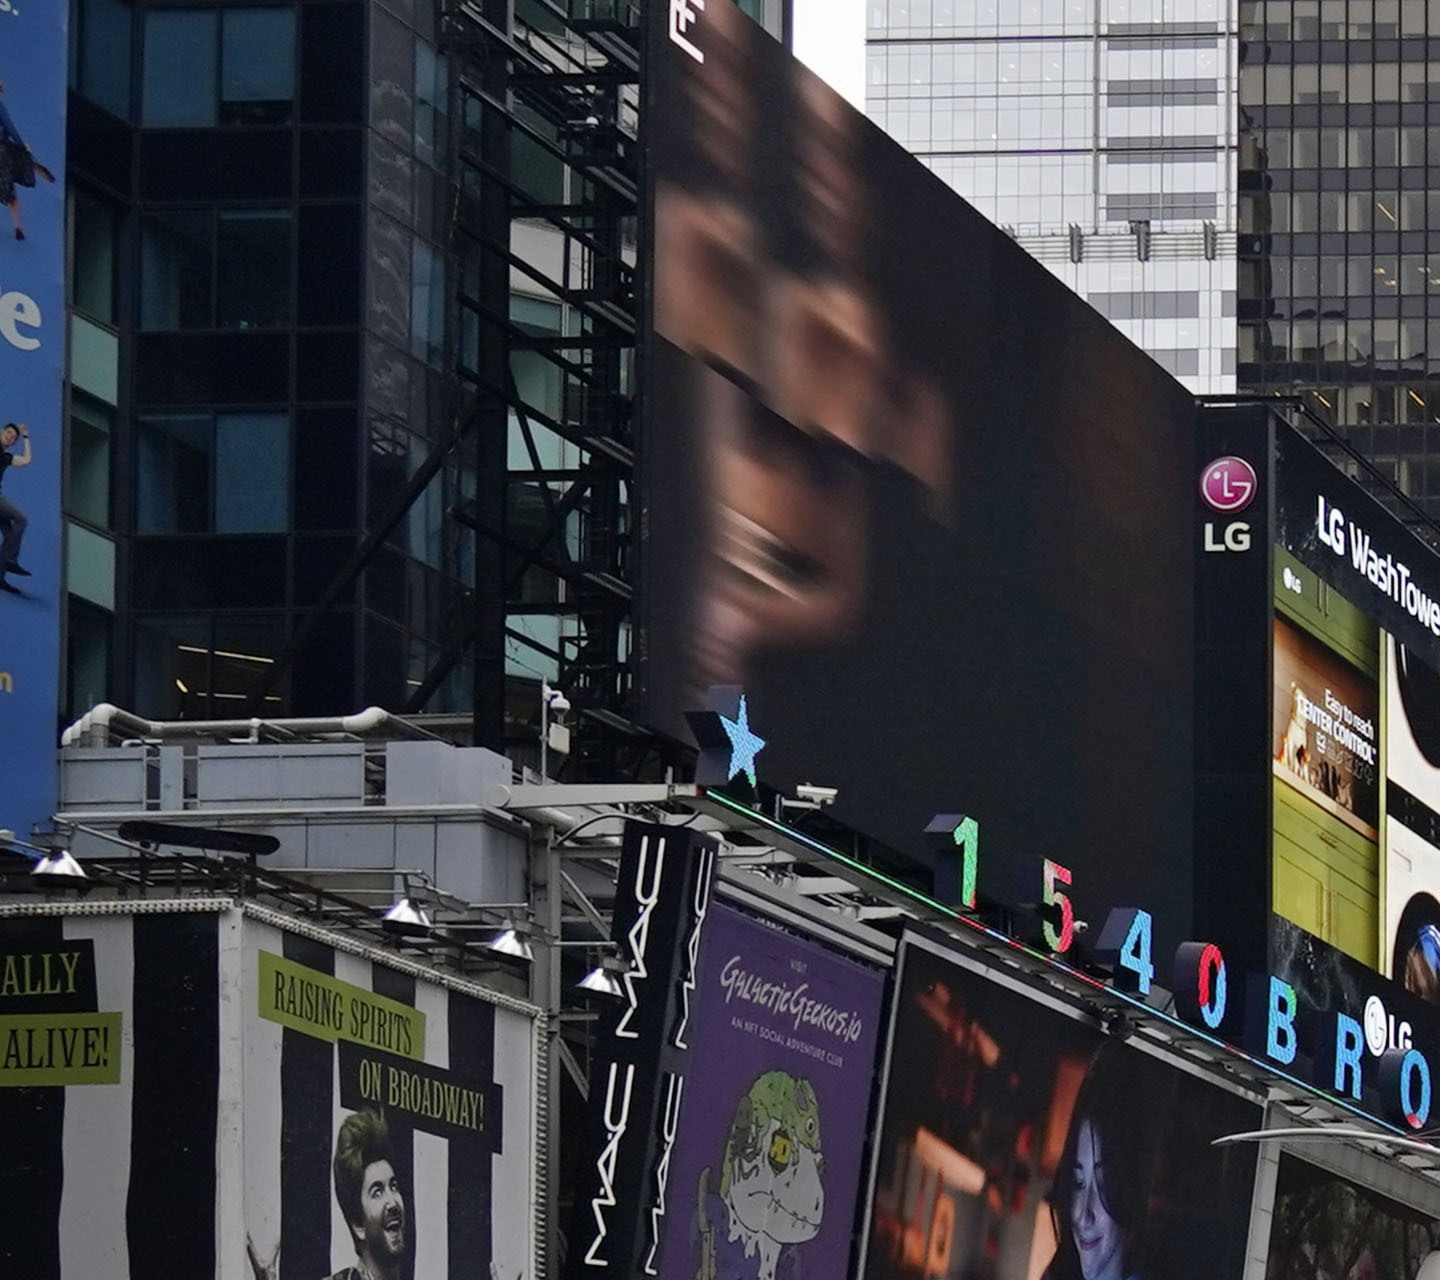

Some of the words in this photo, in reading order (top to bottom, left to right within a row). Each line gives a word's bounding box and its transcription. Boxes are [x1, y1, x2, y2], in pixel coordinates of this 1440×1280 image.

[1204, 523, 1251, 552] LG
[1318, 495, 1345, 555] LG
[955, 816, 1227, 1029] 1540
[273, 972, 345, 1034] RAISING
[350, 992, 412, 1056] SPIRITS
[731, 1017, 743, 1029] AN
[744, 1021, 758, 1034] NFT
[760, 1025, 784, 1045] SOCIAL
[786, 1038, 826, 1061] ADVENTURE
[826, 1053, 843, 1067] CLUB
[2, 1025, 112, 1070] ALIVE!
[358, 1060, 382, 1098] ON
[388, 1070, 486, 1131] BROADWAY!
